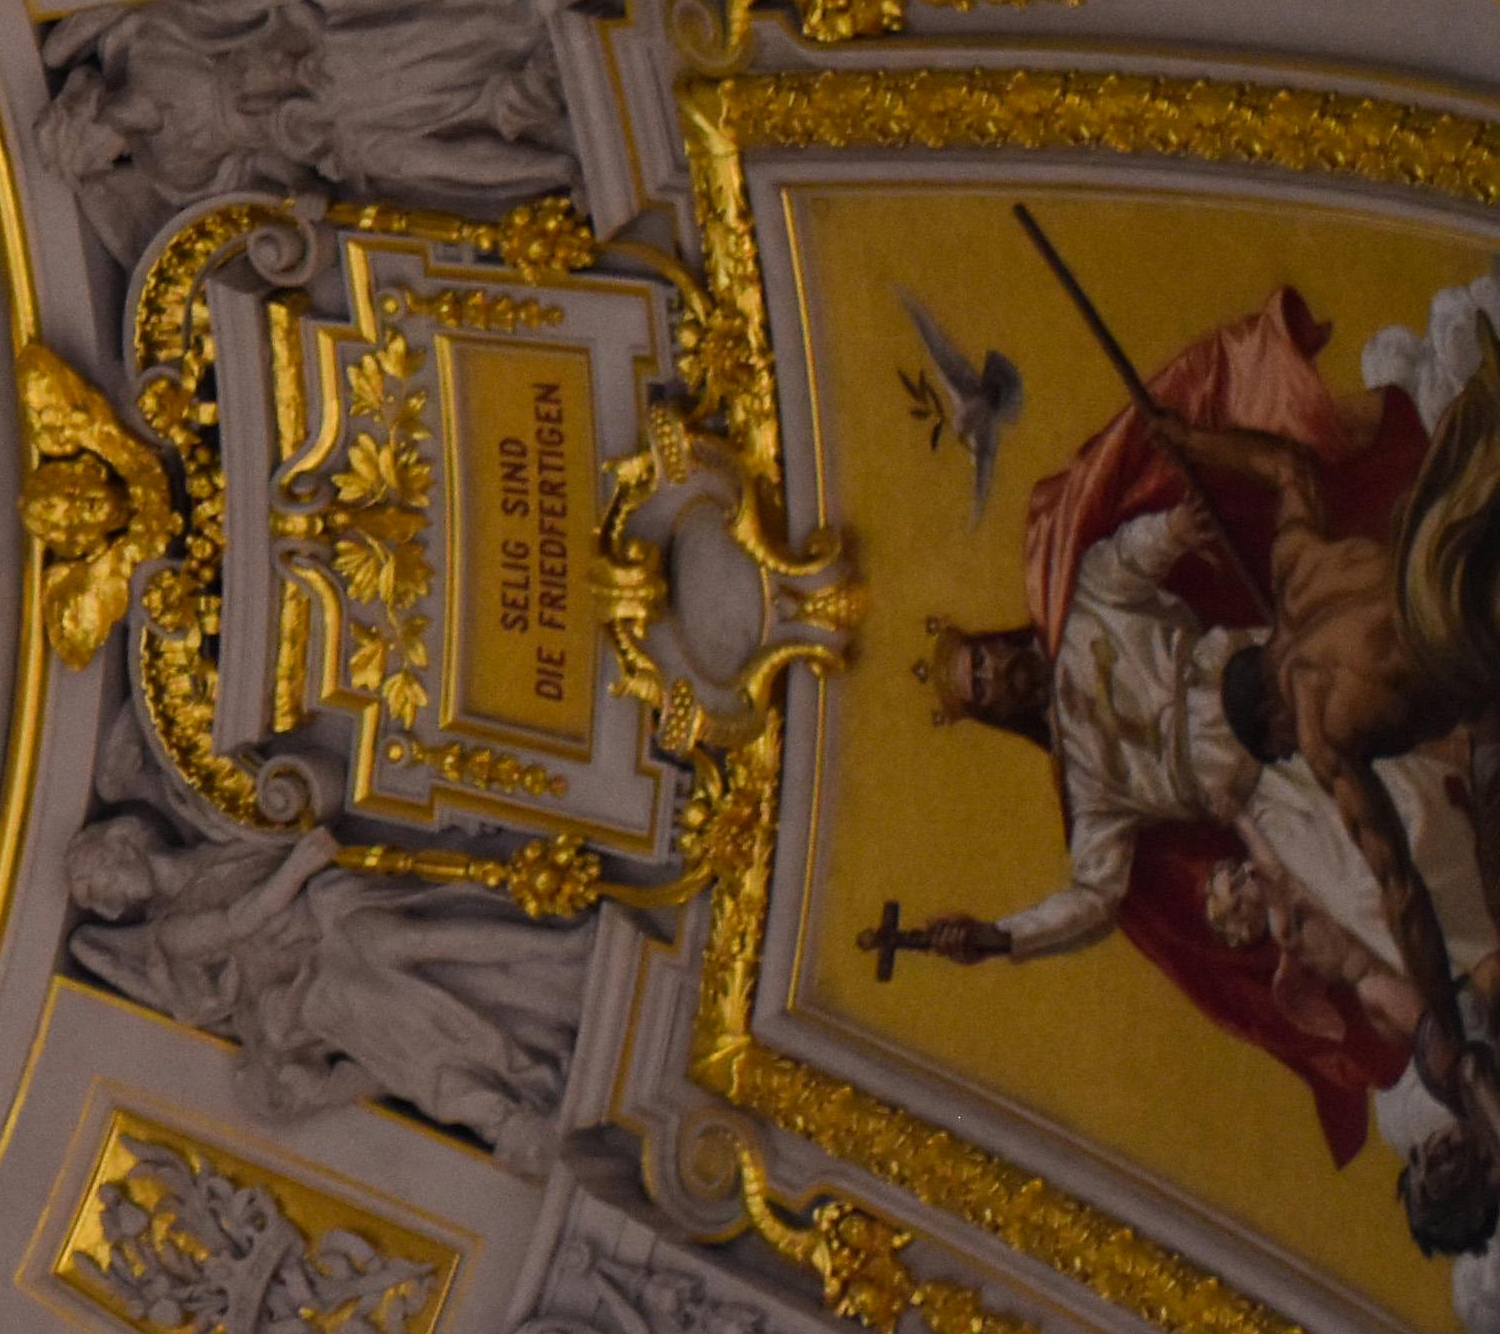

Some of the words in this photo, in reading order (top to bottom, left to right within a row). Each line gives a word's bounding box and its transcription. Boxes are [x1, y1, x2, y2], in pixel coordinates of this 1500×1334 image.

[500, 437, 531, 518] SIND
[533, 381, 568, 631] FRIEDFERTIGEN
[501, 540, 531, 634] SELIG
[535, 646, 566, 703] DIE
